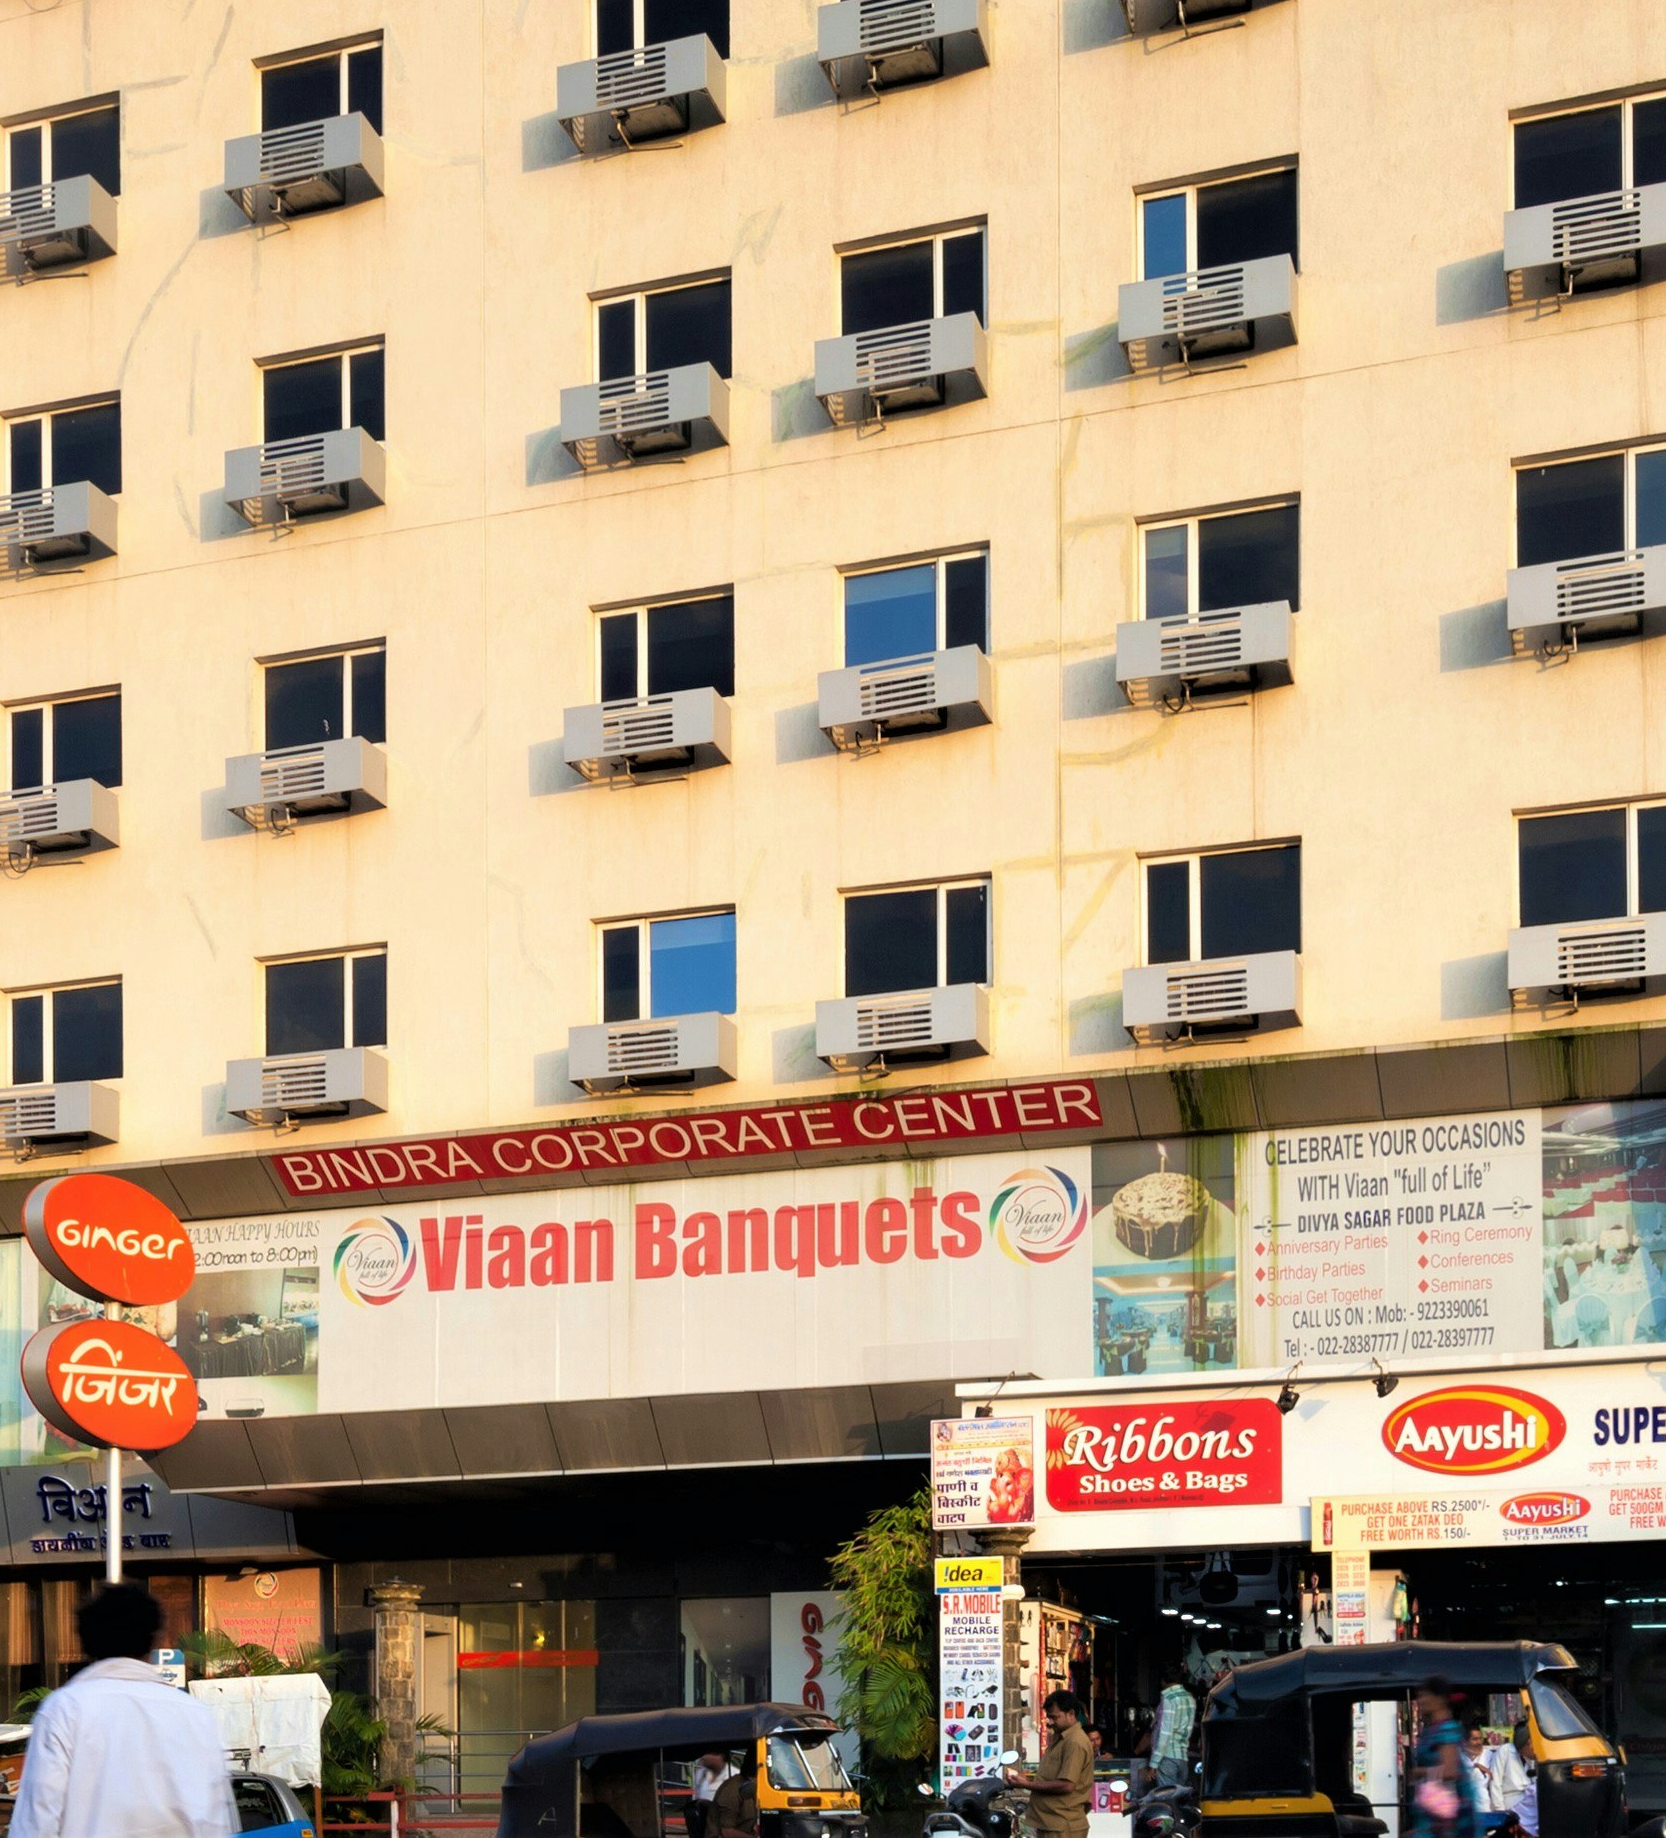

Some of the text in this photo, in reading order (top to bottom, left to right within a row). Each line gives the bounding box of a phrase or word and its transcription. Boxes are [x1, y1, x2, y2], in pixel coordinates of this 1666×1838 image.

[282, 1084, 1101, 1192] BINDRA CORPORATE CENTER
[1265, 1119, 1525, 1166] CELEBRATE YOUR OCCASIONS
[1297, 1175, 1339, 1202] WITH
[1345, 1172, 1388, 1197] Viaan
[1433, 1165, 1448, 1192] of
[1006, 1200, 1061, 1227] Viaan
[1298, 1202, 1485, 1233] DIVYA SAGAR FOOD PLAZA
[225, 1220, 320, 1243] HAPPY HOURS
[419, 1187, 982, 1292] Viaan Banquets
[1431, 1226, 1533, 1246] Ring Ceremony
[1267, 1235, 1388, 1257] Anniversary Parties
[251, 1251, 263, 1262] to
[347, 1247, 394, 1271] Viaan
[1431, 1251, 1514, 1269] Conferences
[1267, 1262, 1365, 1282] Birthday Parties
[1431, 1276, 1492, 1293] Seminars
[1267, 1288, 1383, 1307] Social Get Together
[1293, 1310, 1321, 1329] CALL
[1325, 1309, 1341, 1327] US
[1345, 1307, 1363, 1326] ON
[1417, 1299, 1489, 1321] 9223390061
[1318, 1327, 1495, 1356] 022-28387777 022-28397777
[59, 1338, 187, 1416] जिंजर
[1064, 1416, 1257, 1472] Ribbons
[1080, 1471, 1248, 1494] Shoes & Bags
[1610, 1487, 1662, 1501] PURCHASE
[1342, 1502, 1392, 1516] PURCHASE
[1396, 1500, 1428, 1512] ABOVE
[1609, 1502, 1627, 1516] GET
[1630, 1501, 1664, 1514] 500GM
[1367, 1513, 1464, 1528] GET ONE ZATAK DEO
[1630, 1516, 1654, 1528] FREE
[1361, 1528, 1423, 1542] FREE WORTH
[1503, 1526, 1588, 1536] SUPER MARKET
[953, 1616, 991, 1624] MOBILE
[945, 1626, 999, 1635] RECHARGE
[159, 1649, 174, 1665] P
